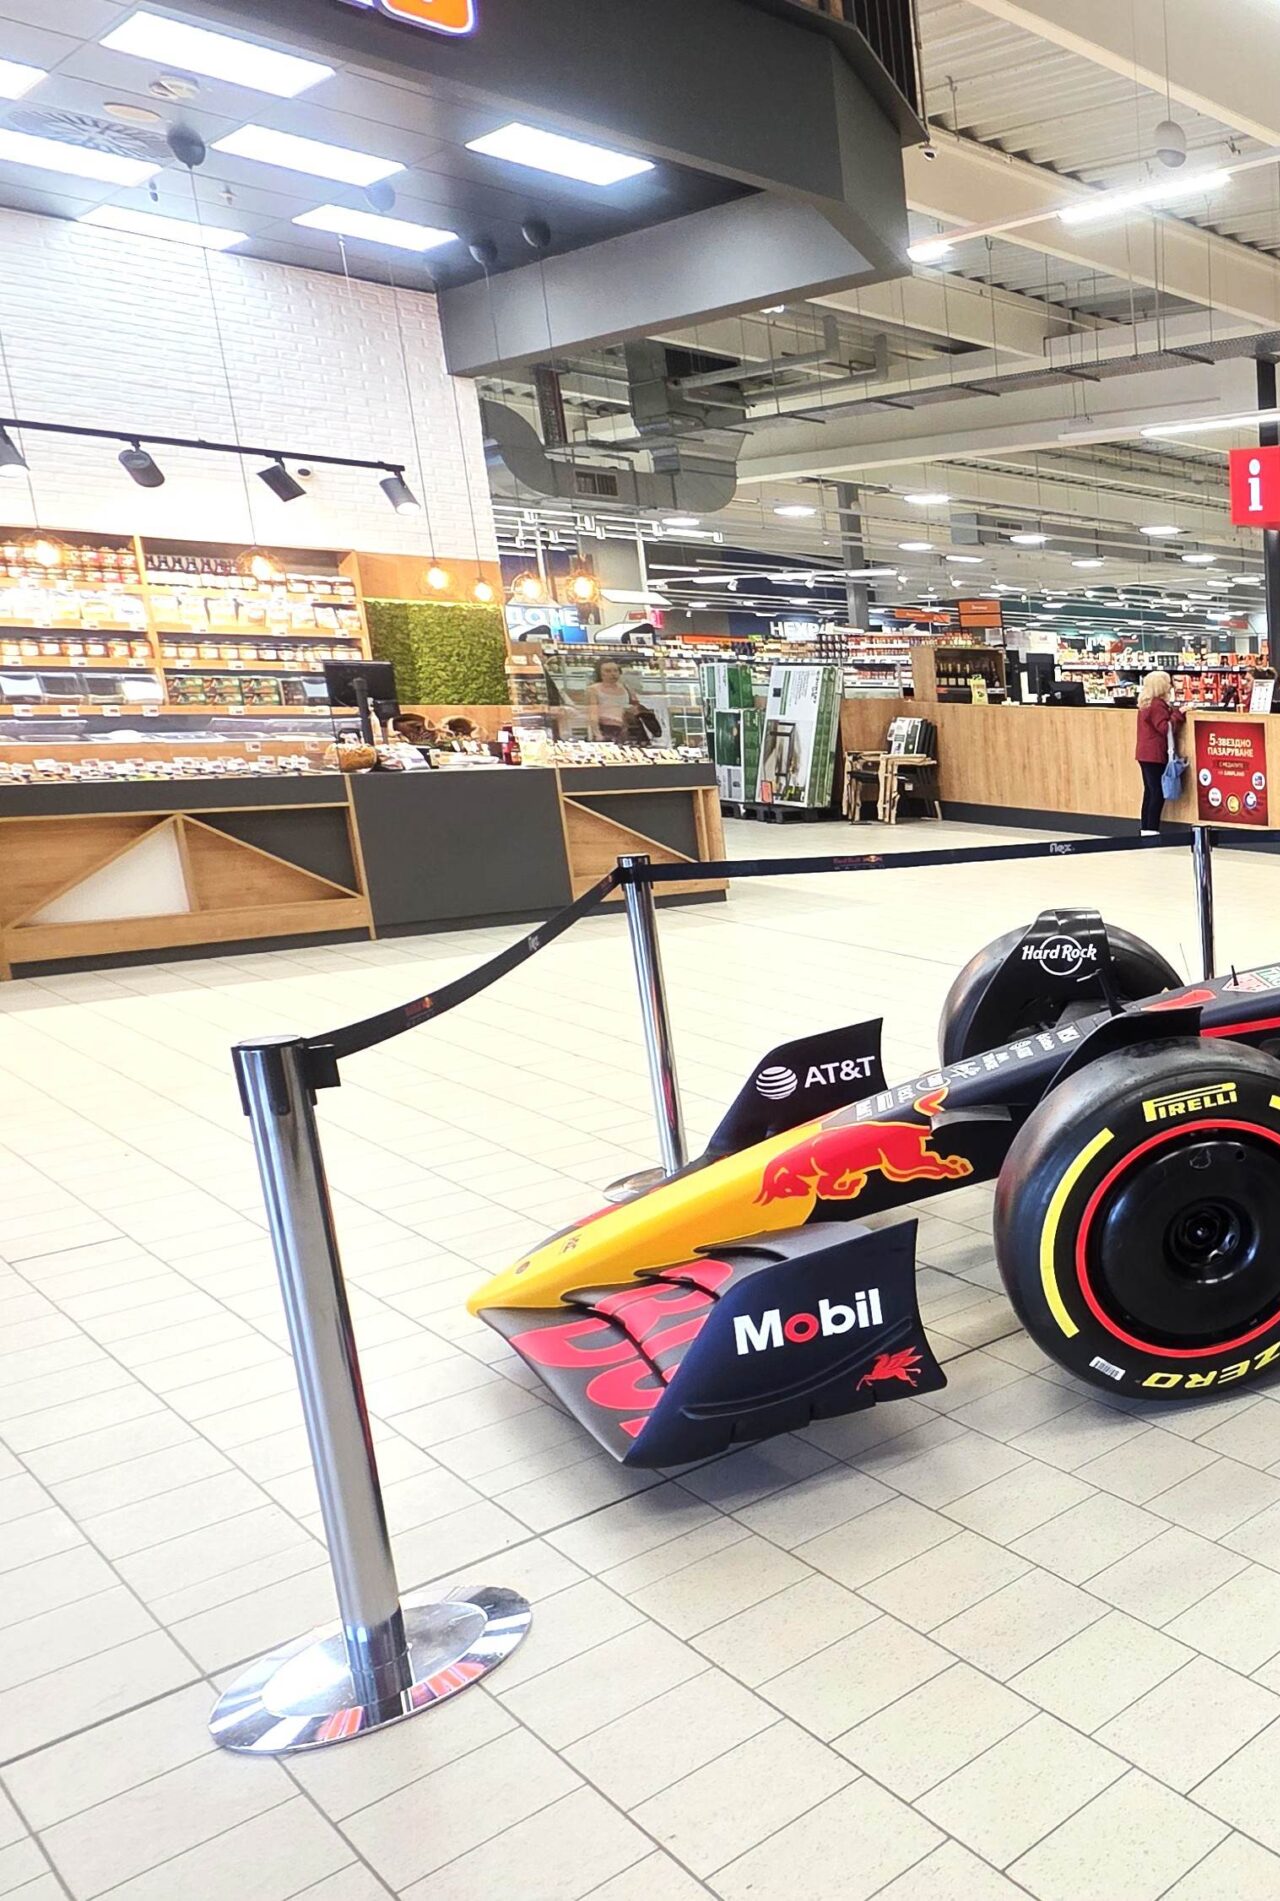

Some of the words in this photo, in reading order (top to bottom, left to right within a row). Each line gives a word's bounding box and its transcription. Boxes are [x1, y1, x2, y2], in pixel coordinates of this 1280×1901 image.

[1022, 944, 1060, 961] Hard
[1061, 943, 1097, 961] Rock
[804, 1056, 876, 1088] AT&T
[1142, 1082, 1238, 1122] PIRELLI
[733, 1288, 883, 1355] Mobil
